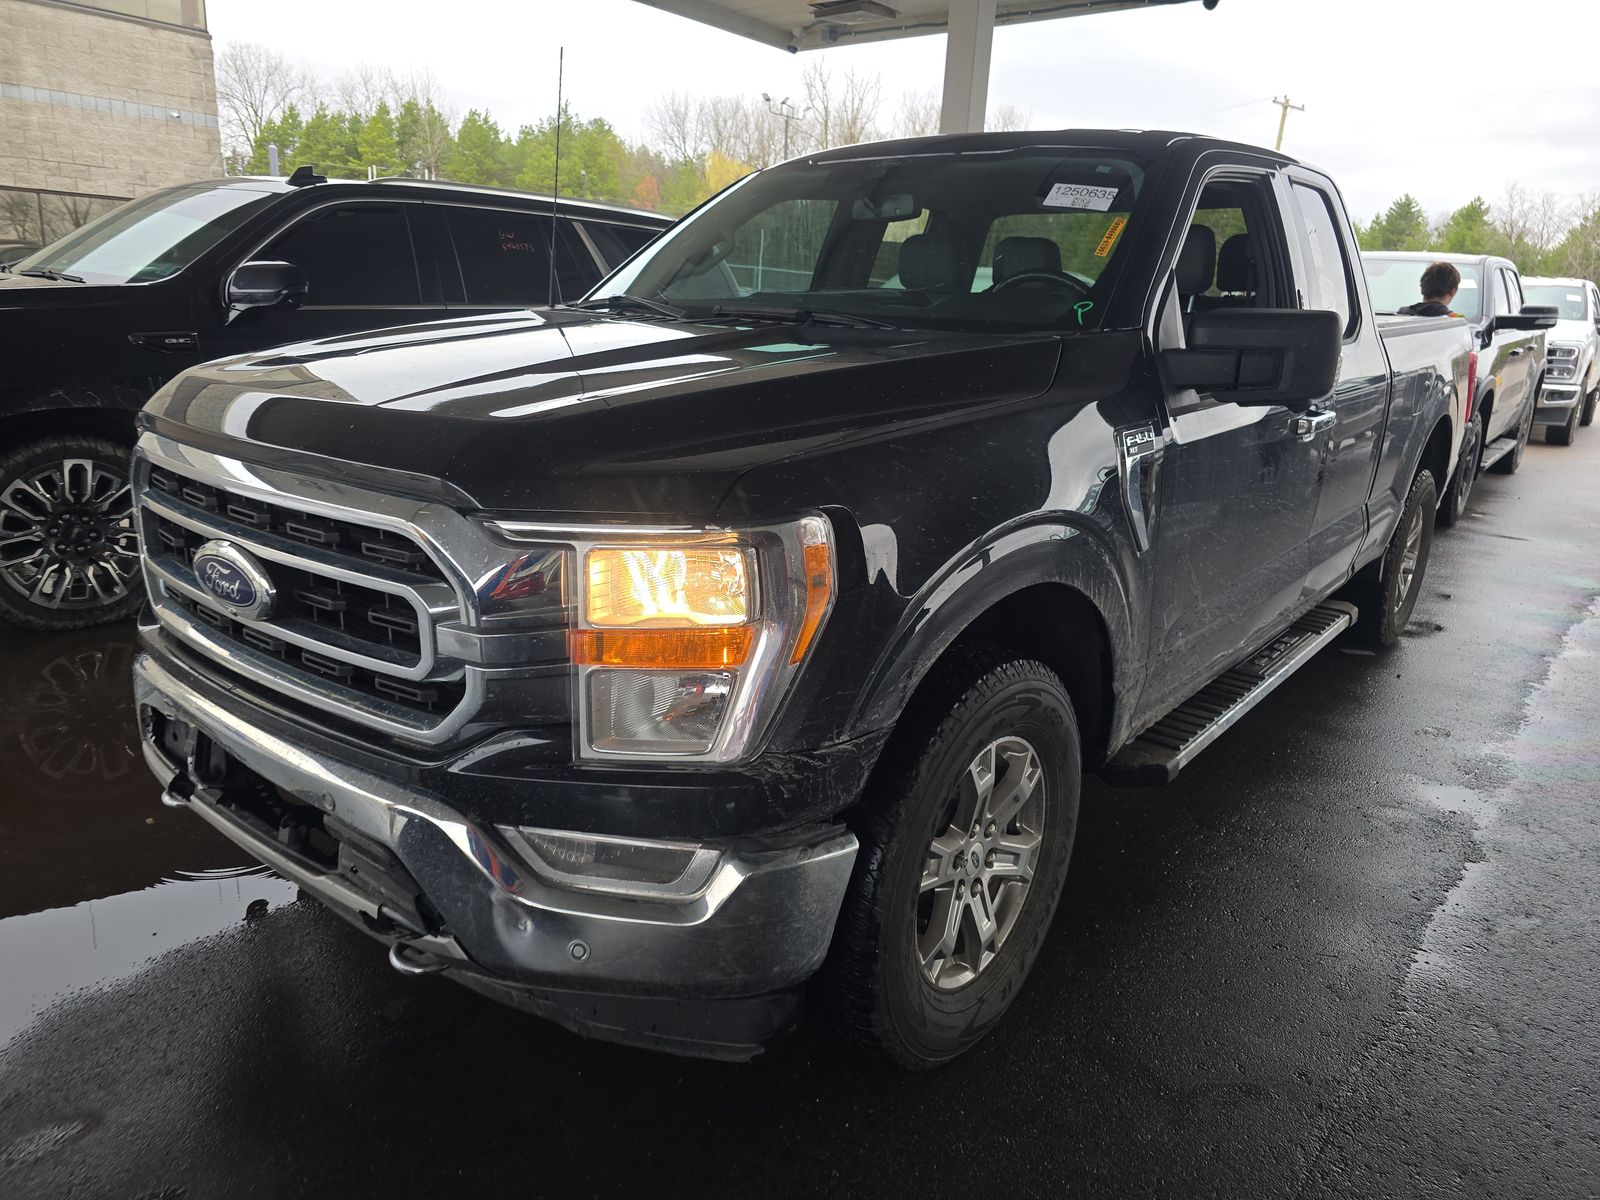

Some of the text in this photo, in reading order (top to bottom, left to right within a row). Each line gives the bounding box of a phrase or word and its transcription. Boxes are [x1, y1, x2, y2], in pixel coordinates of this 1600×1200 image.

[1054, 186, 1117, 200] 1250635
[1073, 301, 1094, 326] P
[204, 561, 241, 600] Ford
